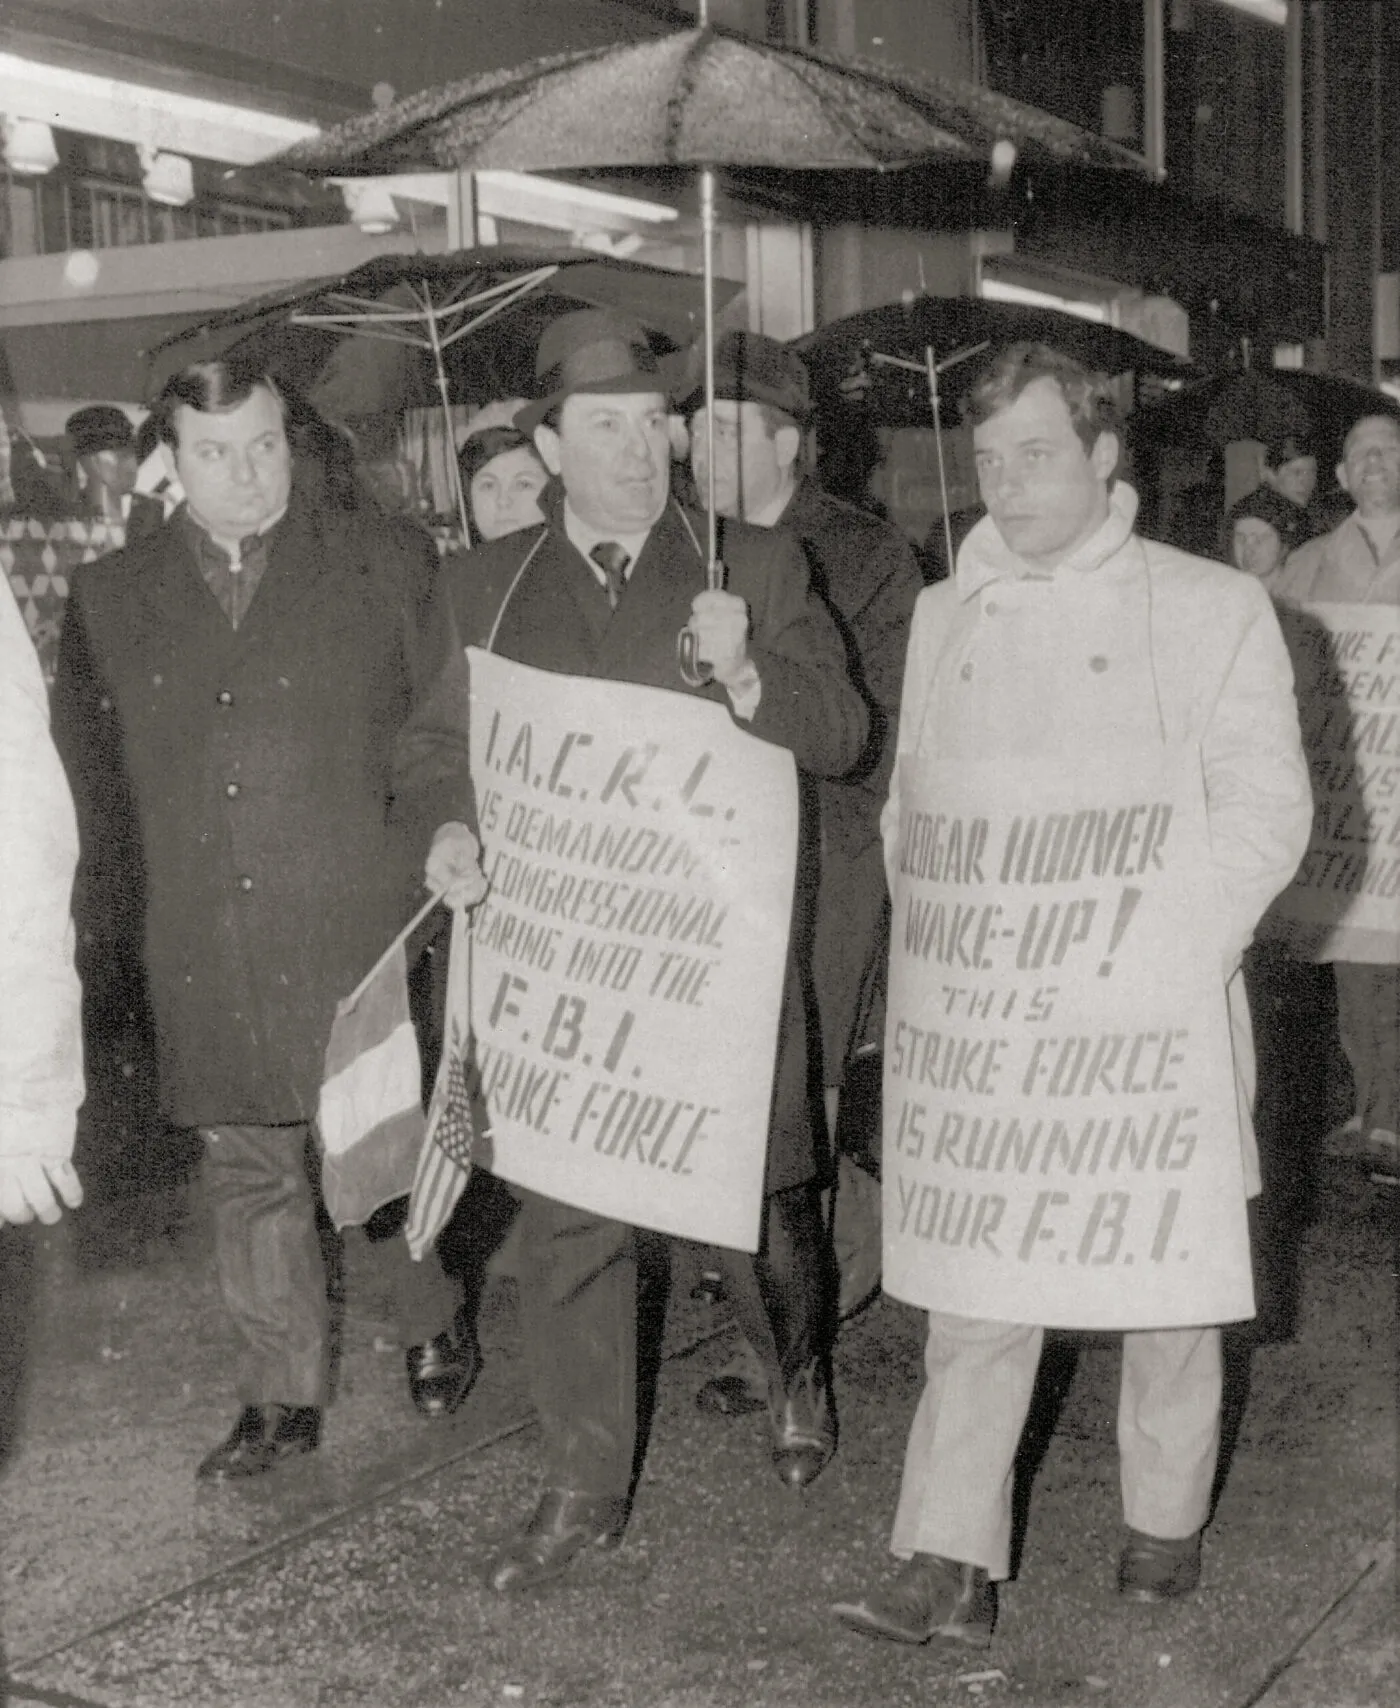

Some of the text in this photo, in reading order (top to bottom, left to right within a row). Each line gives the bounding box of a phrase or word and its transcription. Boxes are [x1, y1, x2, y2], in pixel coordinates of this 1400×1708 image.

[479, 787, 740, 881] IS DEMANDIN
[999, 803, 1173, 886] HOOVER
[487, 849, 731, 951] CONGRESSIONAL
[565, 936, 643, 992] INTO
[649, 951, 721, 1006] THE
[942, 985, 1060, 1022] THIS
[488, 971, 642, 1079] F.B.I.
[892, 1020, 1189, 1097] STRIKE FORCE
[480, 1042, 721, 1176] RIKE FORCE
[896, 1099, 1199, 1176] IS RUNNING
[898, 1173, 1189, 1266] YOUR F.B.I.
